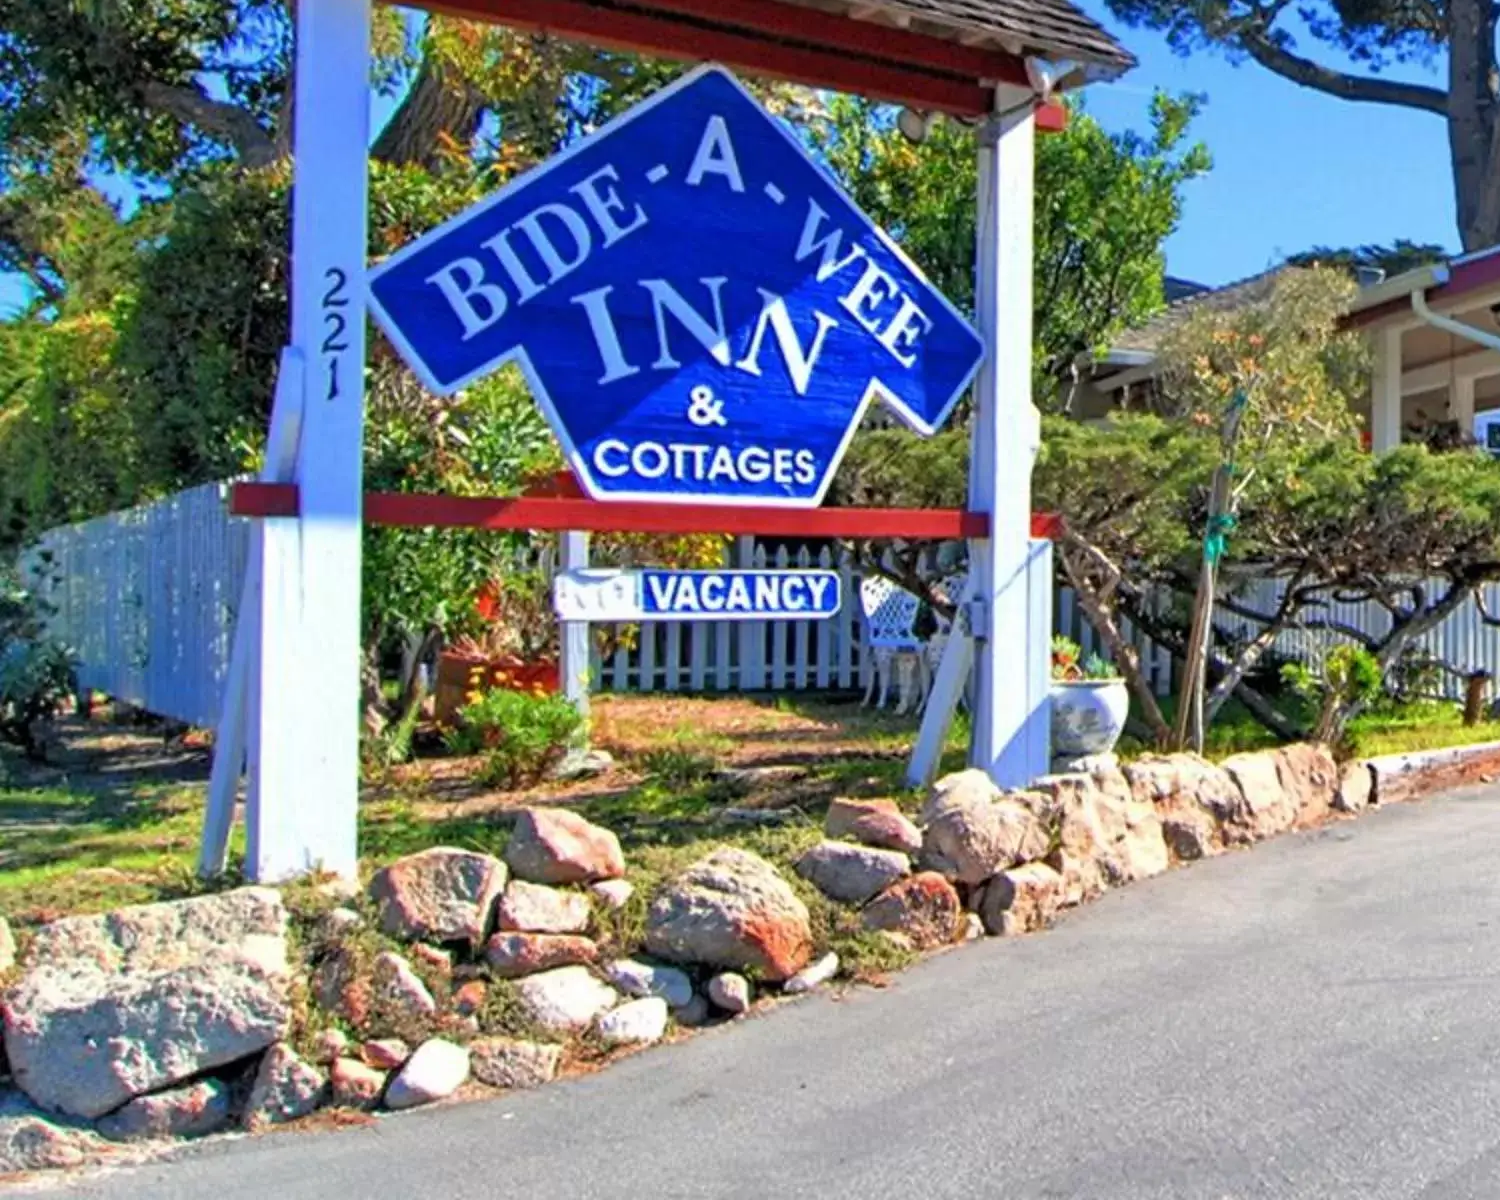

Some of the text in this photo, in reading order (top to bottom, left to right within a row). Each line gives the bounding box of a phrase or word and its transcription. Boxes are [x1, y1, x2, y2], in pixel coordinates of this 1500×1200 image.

[322, 268, 350, 400] 221
[571, 275, 838, 395] INN
[687, 385, 727, 426] &
[594, 439, 816, 485] COTTAGES
[648, 574, 830, 611] VACANCY
